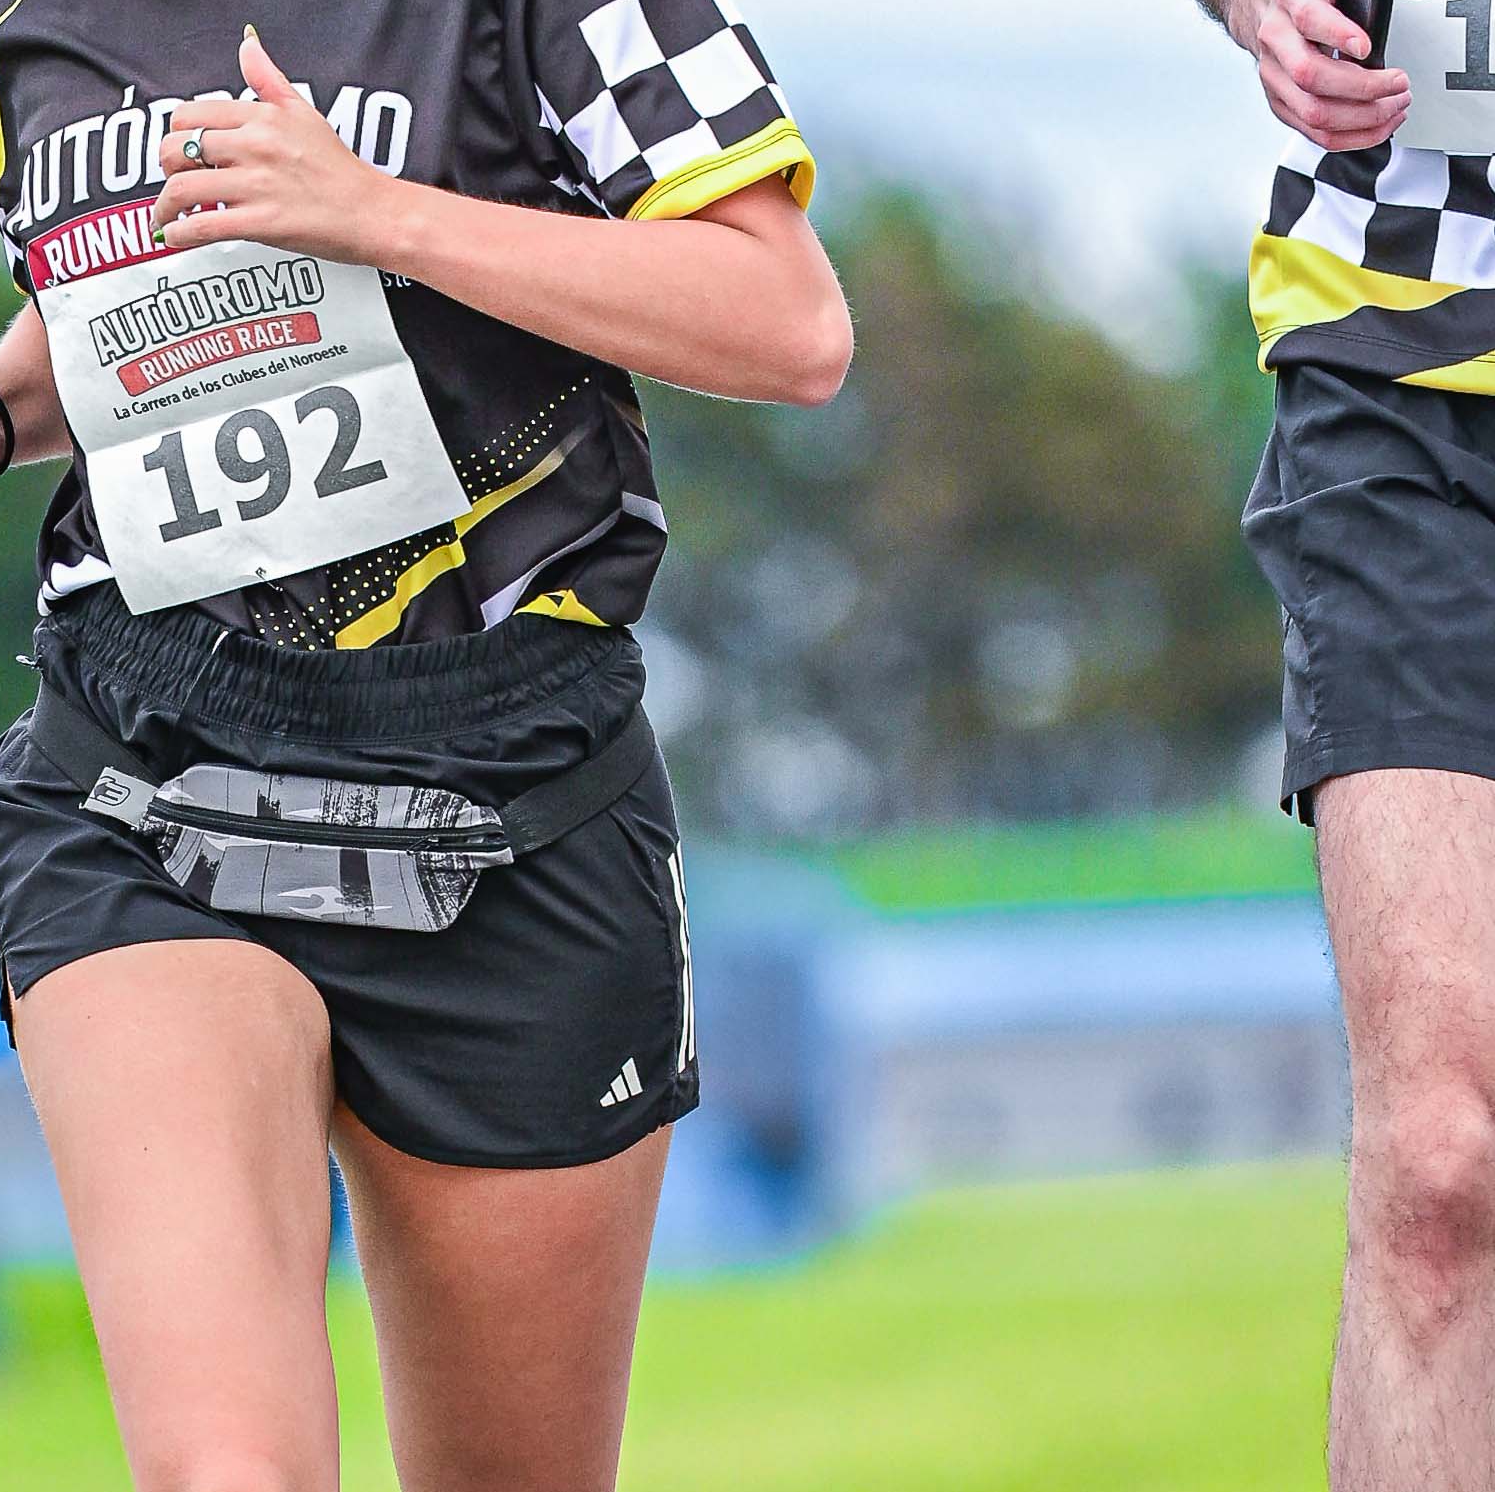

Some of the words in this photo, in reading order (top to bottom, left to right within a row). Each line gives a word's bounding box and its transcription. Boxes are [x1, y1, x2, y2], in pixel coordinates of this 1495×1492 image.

[5, 83, 413, 237] AUTÓDMO
[88, 257, 325, 367] AUTÓDROMO
[138, 332, 233, 385] RUNNING
[235, 320, 297, 351] RACE
[113, 407, 131, 421] La
[132, 391, 181, 415] Carrera
[182, 386, 201, 400] de
[200, 380, 222, 394] los
[222, 367, 267, 388] Clubes
[269, 358, 289, 375] del
[289, 343, 349, 370] Noroeste
[143, 385, 388, 543] 192
